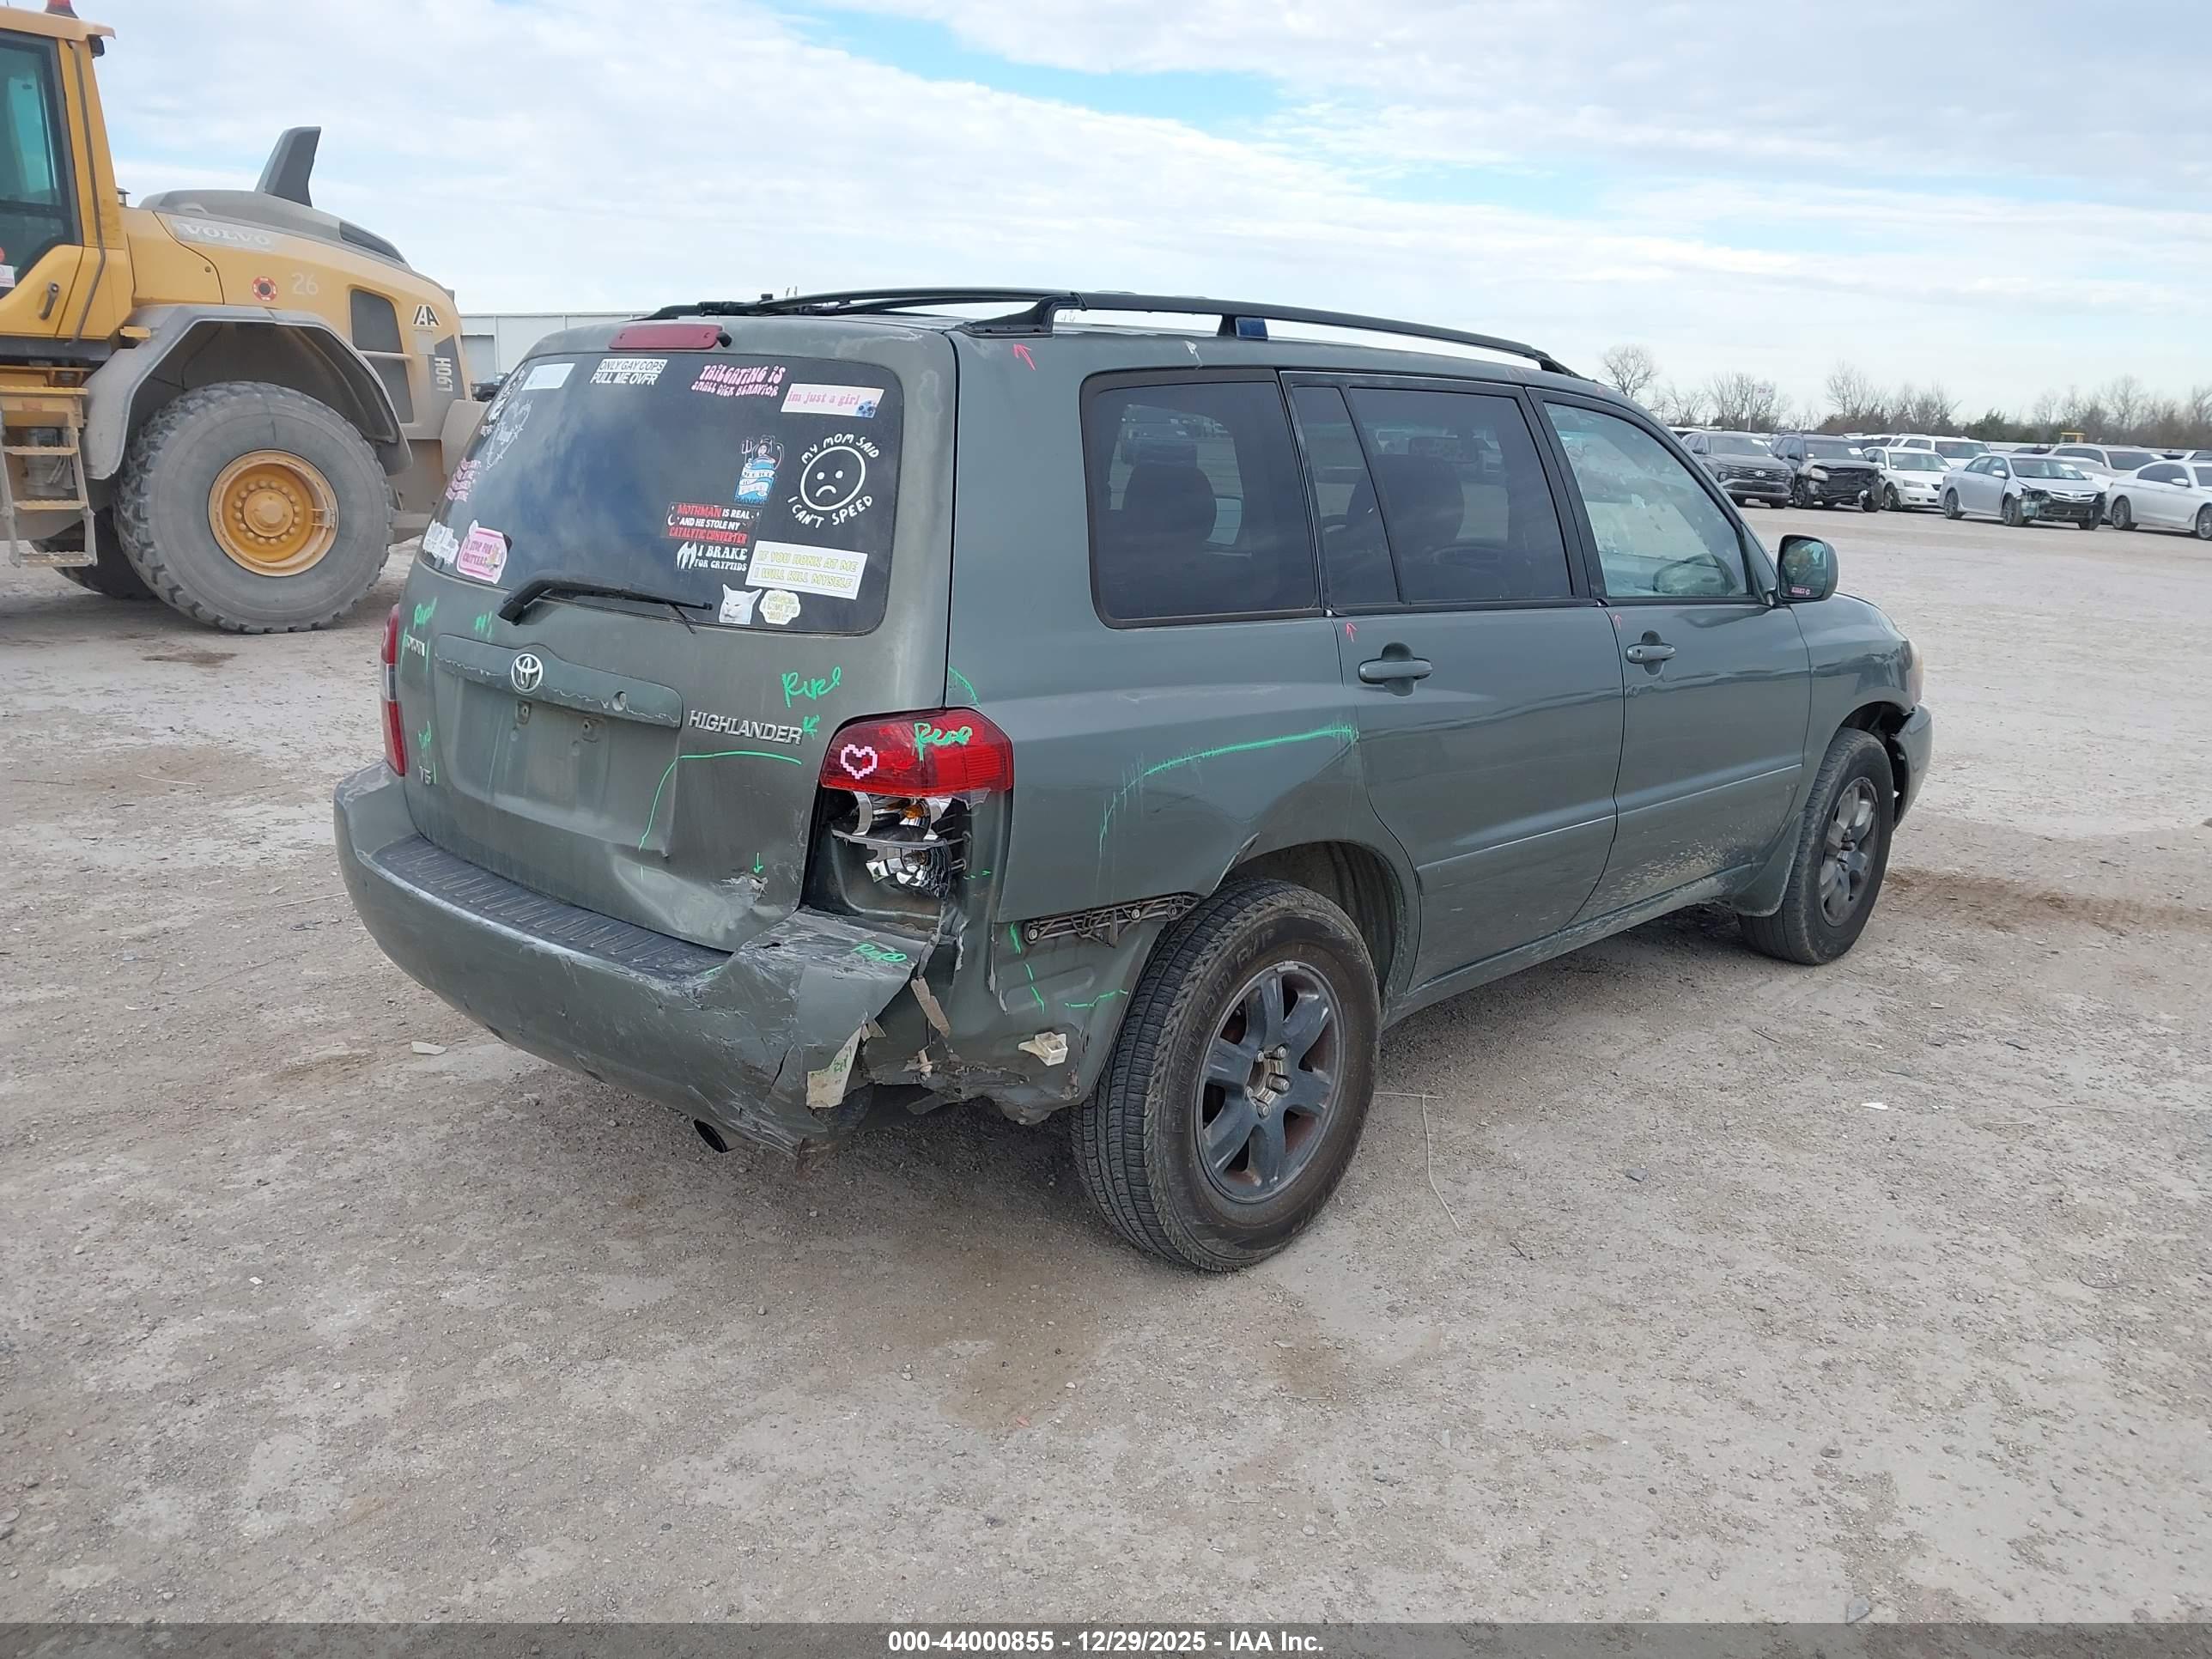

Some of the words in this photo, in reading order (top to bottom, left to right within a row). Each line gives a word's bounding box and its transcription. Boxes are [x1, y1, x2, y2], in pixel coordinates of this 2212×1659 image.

[178, 222, 270, 245] VOLVO
[291, 272, 319, 295] 26
[434, 357, 453, 392] L90H
[599, 361, 621, 370] ONLY
[621, 361, 640, 371] GAY
[639, 362, 665, 372] COPS
[590, 372, 613, 384] PULL
[613, 373, 631, 384] ME
[691, 380, 717, 393] SMALL
[803, 392, 827, 404] just
[838, 394, 860, 406] girl
[800, 444, 818, 465] MY
[823, 434, 855, 448] MOM
[856, 436, 879, 458] SAID
[678, 504, 722, 518] MOTHMAN
[722, 508, 731, 517] IS
[731, 509, 750, 520] REAL
[792, 504, 824, 529] CAN'T
[831, 495, 873, 526] SPEED
[679, 518, 695, 527] AND
[695, 518, 705, 528] HE
[705, 519, 728, 530] STOLE
[727, 520, 741, 531] MY
[670, 526, 707, 540] CATALYTIC
[706, 530, 748, 544] CONVERTER
[697, 545, 705, 557] I
[705, 546, 748, 561] BRAKE
[757, 550, 769, 562] IF
[771, 550, 792, 564] YOU
[792, 553, 823, 567] HONK
[824, 557, 839, 568] AT
[839, 560, 860, 573] ME
[694, 558, 709, 568] FOR
[710, 560, 748, 572] CRYPTIDS
[762, 568, 785, 580] WILL
[786, 570, 808, 583] KILL
[811, 573, 853, 588] MYSELF
[689, 709, 804, 745] HIGHLANDER
